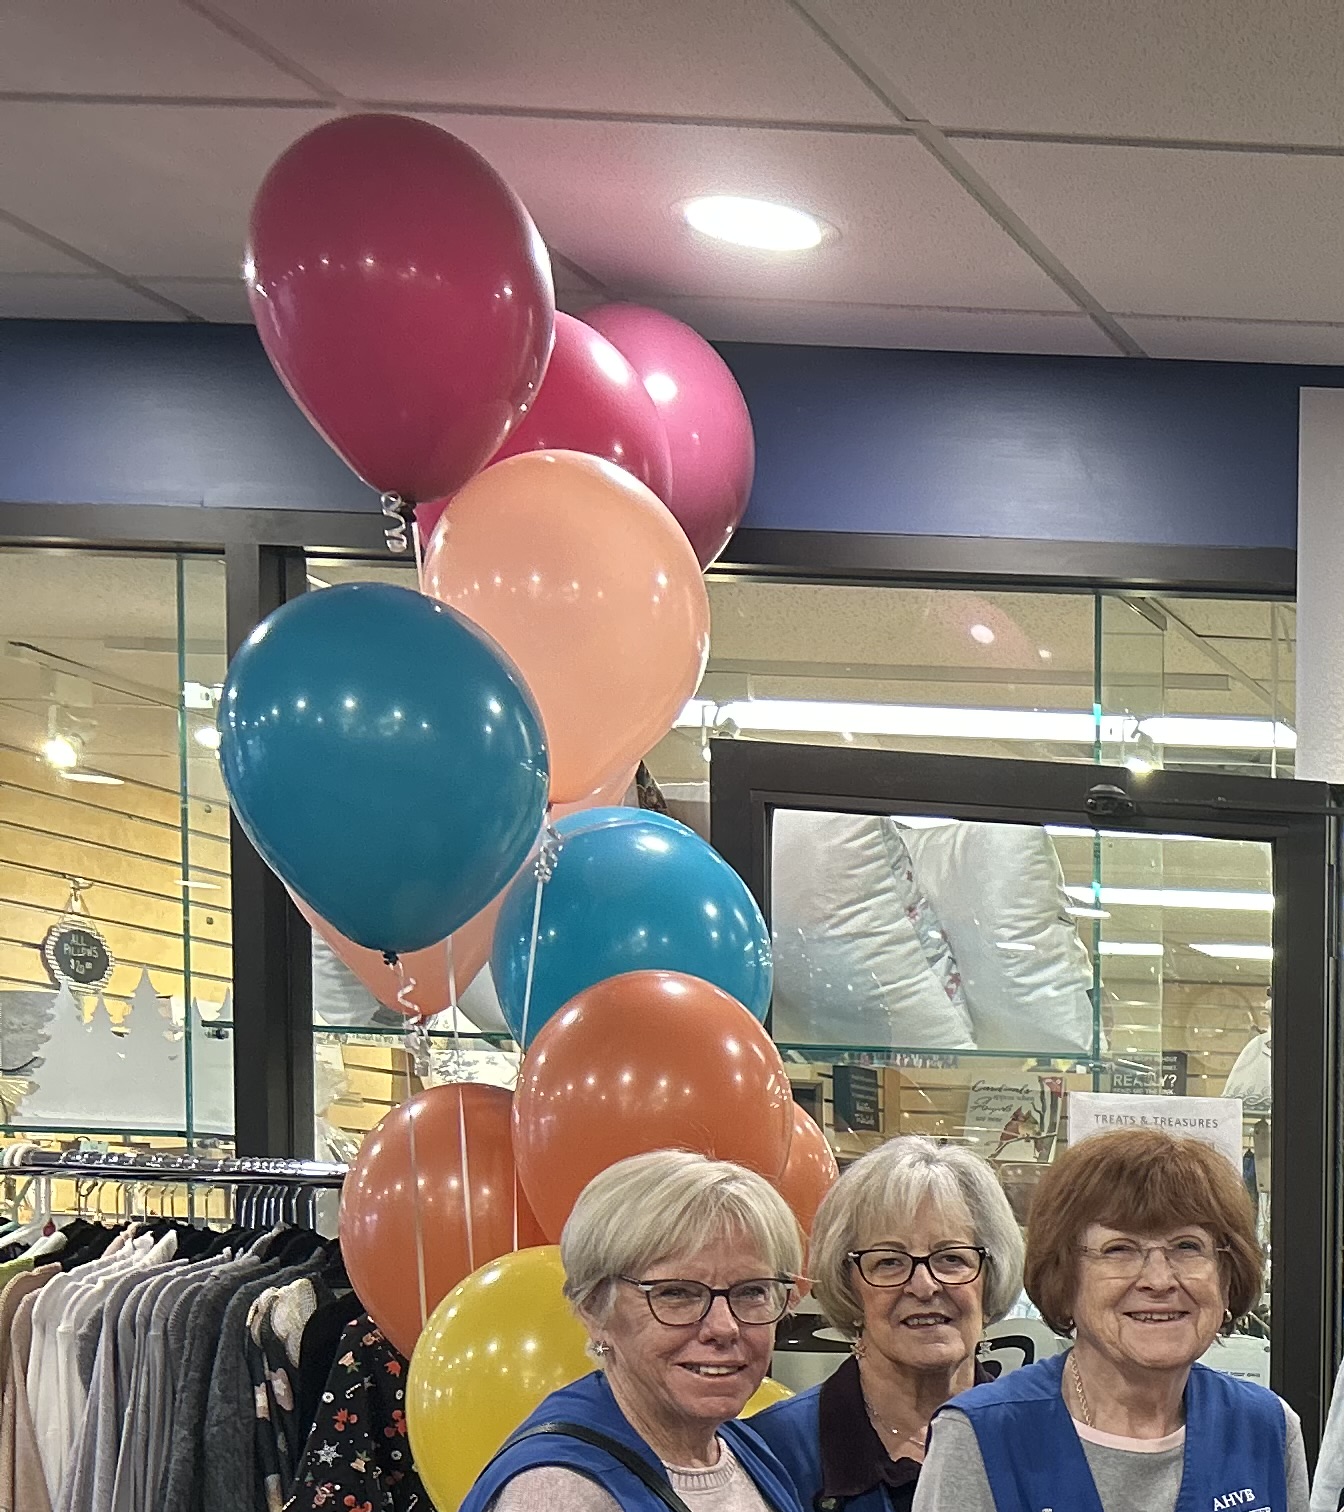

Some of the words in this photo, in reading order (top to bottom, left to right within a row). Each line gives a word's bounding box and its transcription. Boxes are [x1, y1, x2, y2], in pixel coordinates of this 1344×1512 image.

[1094, 1114, 1136, 1125] TREATS
[1140, 1115, 1148, 1125] &
[1153, 1116, 1219, 1129] TREASURES
[1213, 1488, 1256, 1511] AHVB
